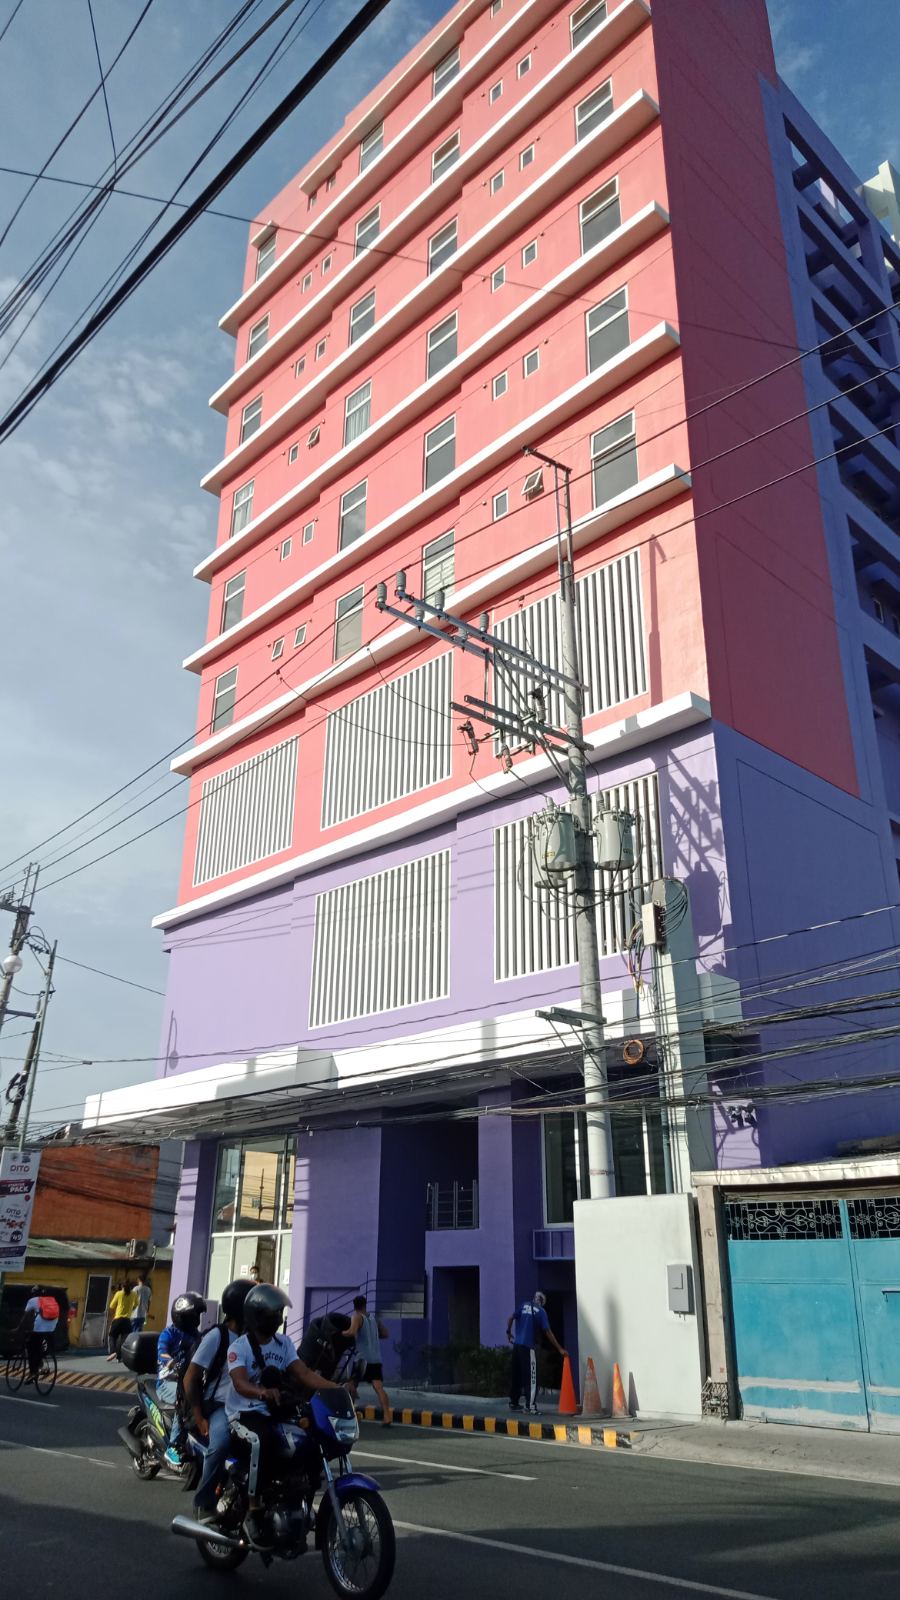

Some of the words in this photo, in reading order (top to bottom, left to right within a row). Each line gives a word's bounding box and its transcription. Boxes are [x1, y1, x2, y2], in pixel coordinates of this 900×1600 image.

[10, 1164, 30, 1172] DITO
[9, 1185, 29, 1193] PACK
[6, 1207, 22, 1216] DITO
